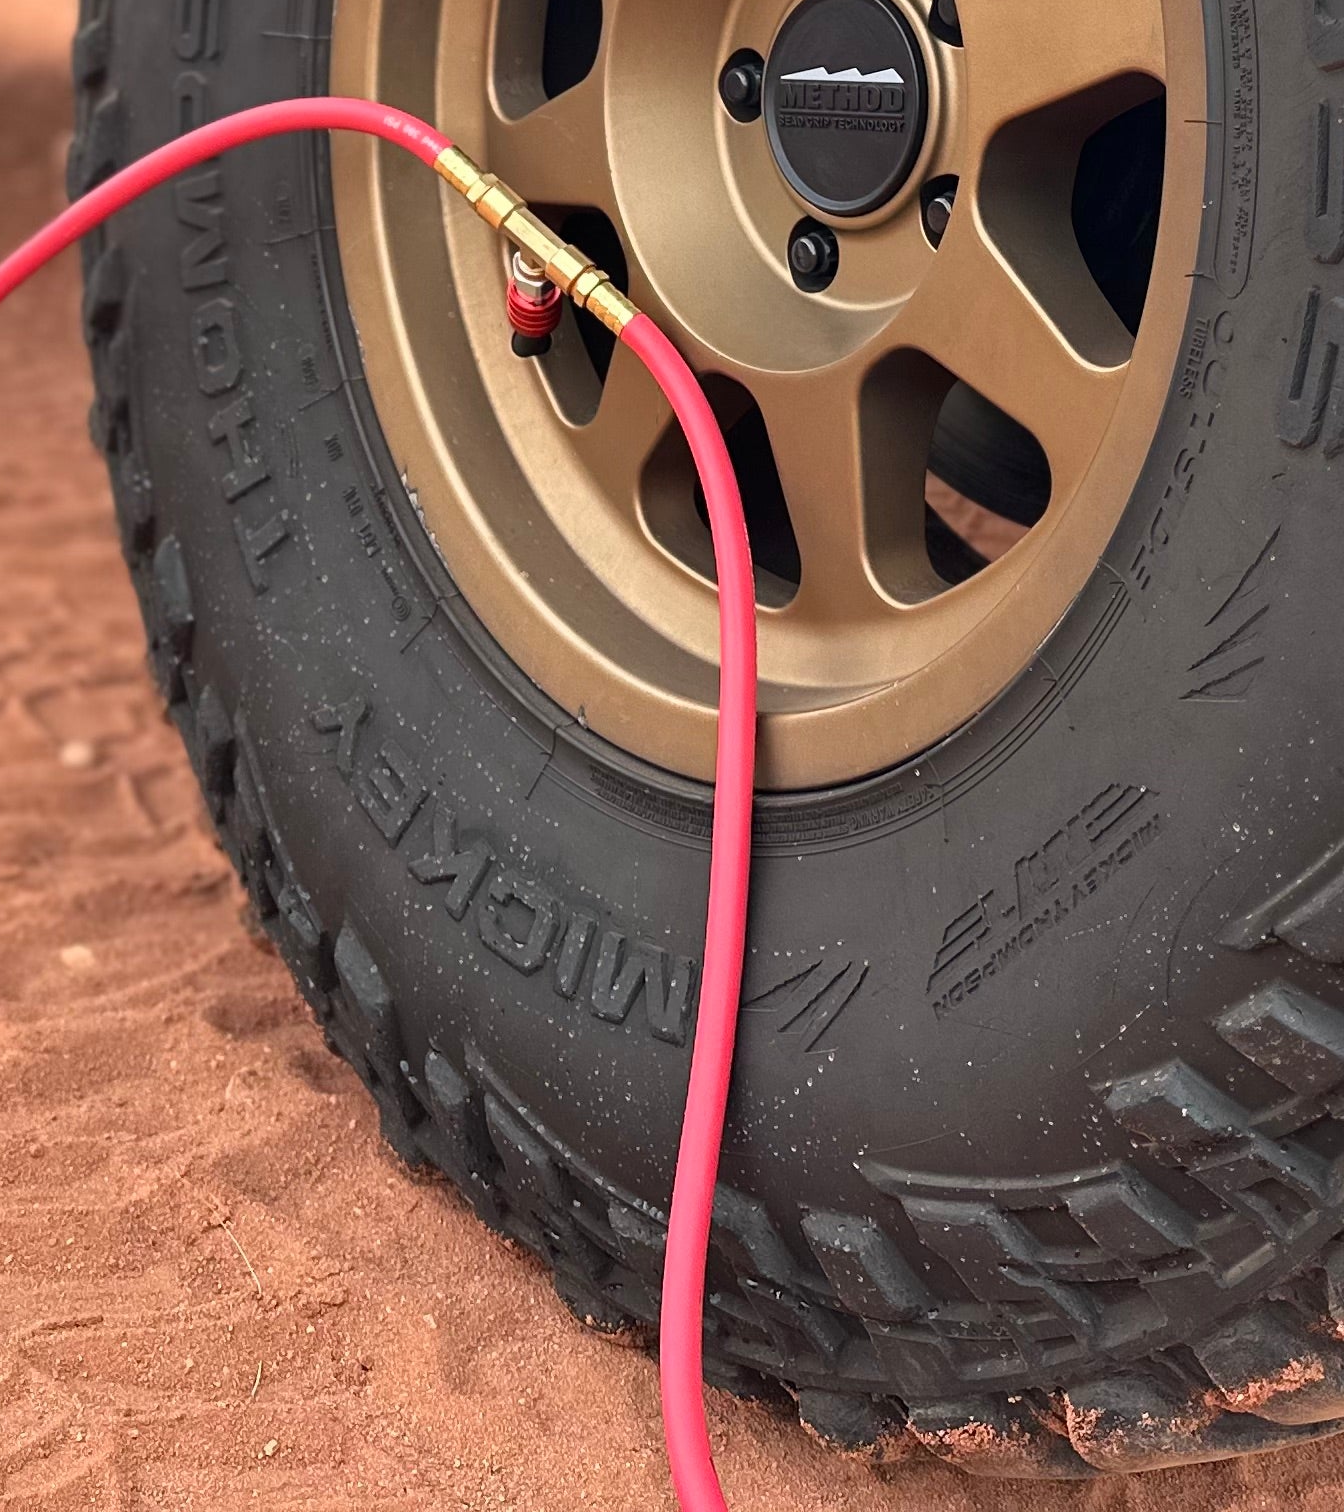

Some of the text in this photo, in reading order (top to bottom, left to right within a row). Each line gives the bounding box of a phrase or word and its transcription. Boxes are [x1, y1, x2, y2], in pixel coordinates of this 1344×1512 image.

[781, 82, 905, 113] METHOD
[833, 118, 905, 133] TECHNOLOGY
[1179, 318, 1212, 401] TUBELESS
[307, 693, 700, 1050] MICKEY
